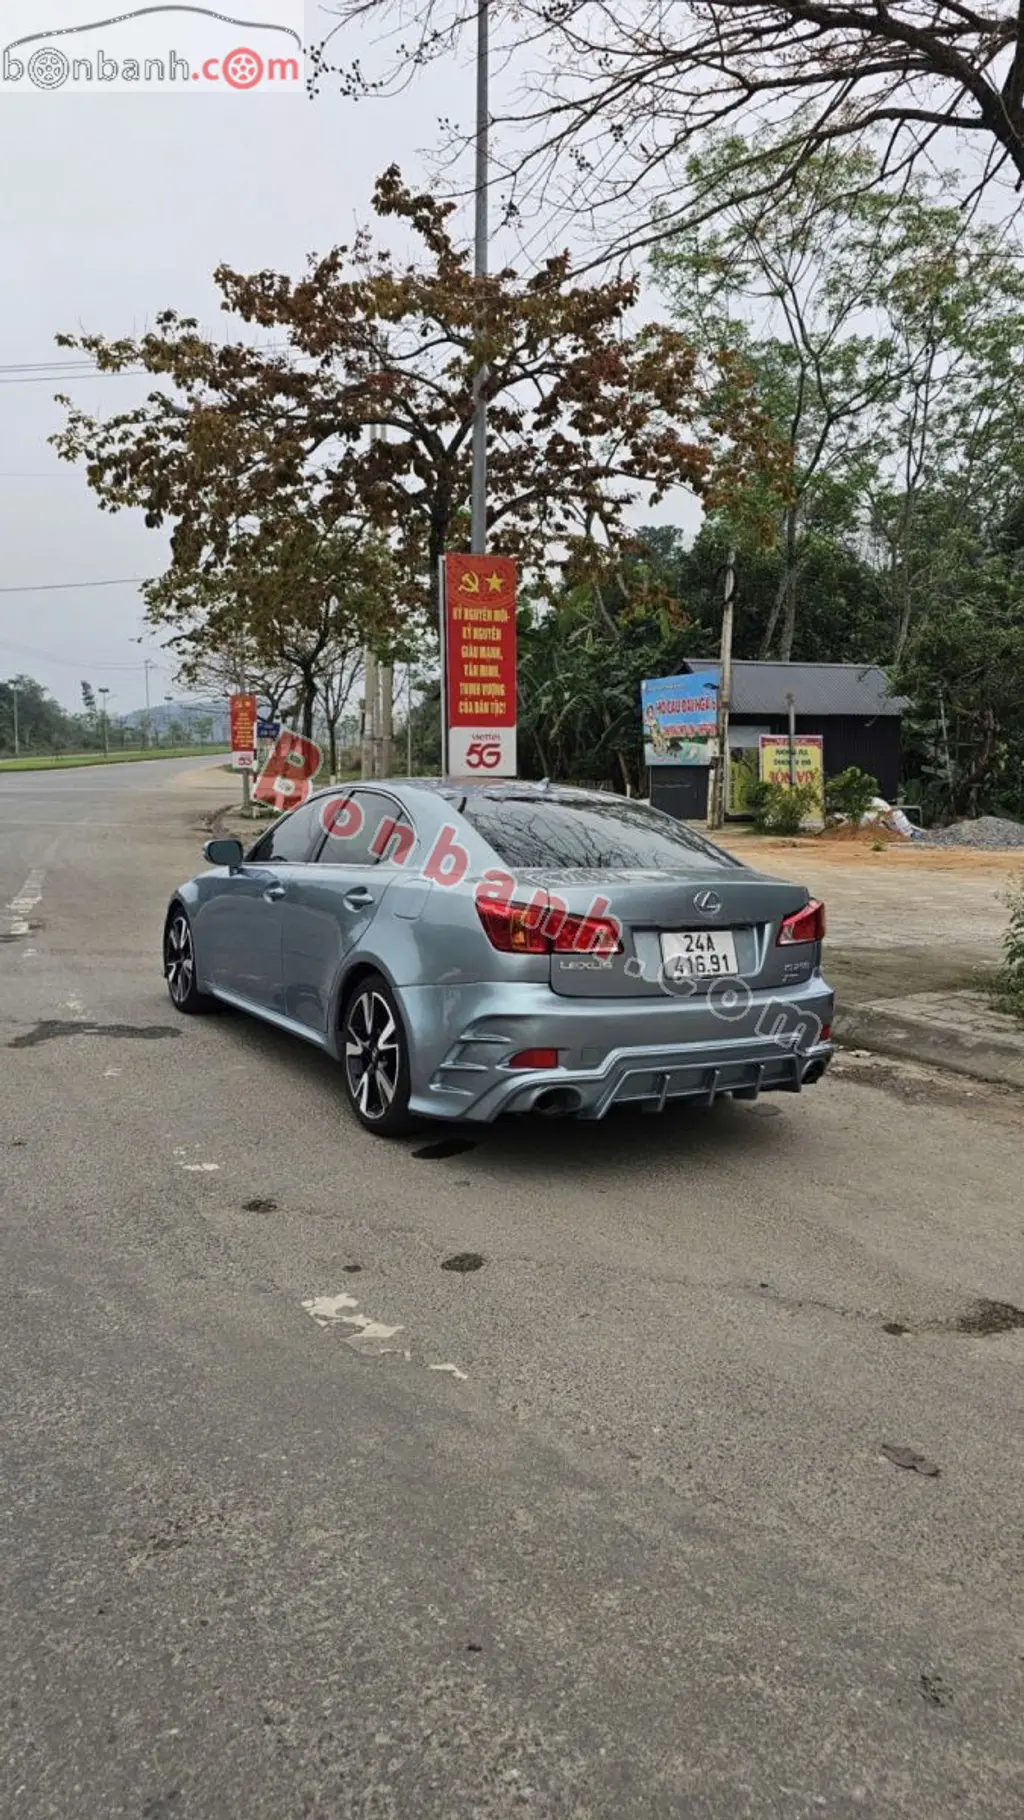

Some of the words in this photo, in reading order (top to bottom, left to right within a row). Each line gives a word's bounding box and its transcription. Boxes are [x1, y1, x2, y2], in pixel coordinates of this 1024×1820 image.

[466, 743, 502, 769] 5G
[683, 933, 716, 953] 24A
[560, 961, 613, 970] LEXUS
[674, 953, 730, 975] 416.91
